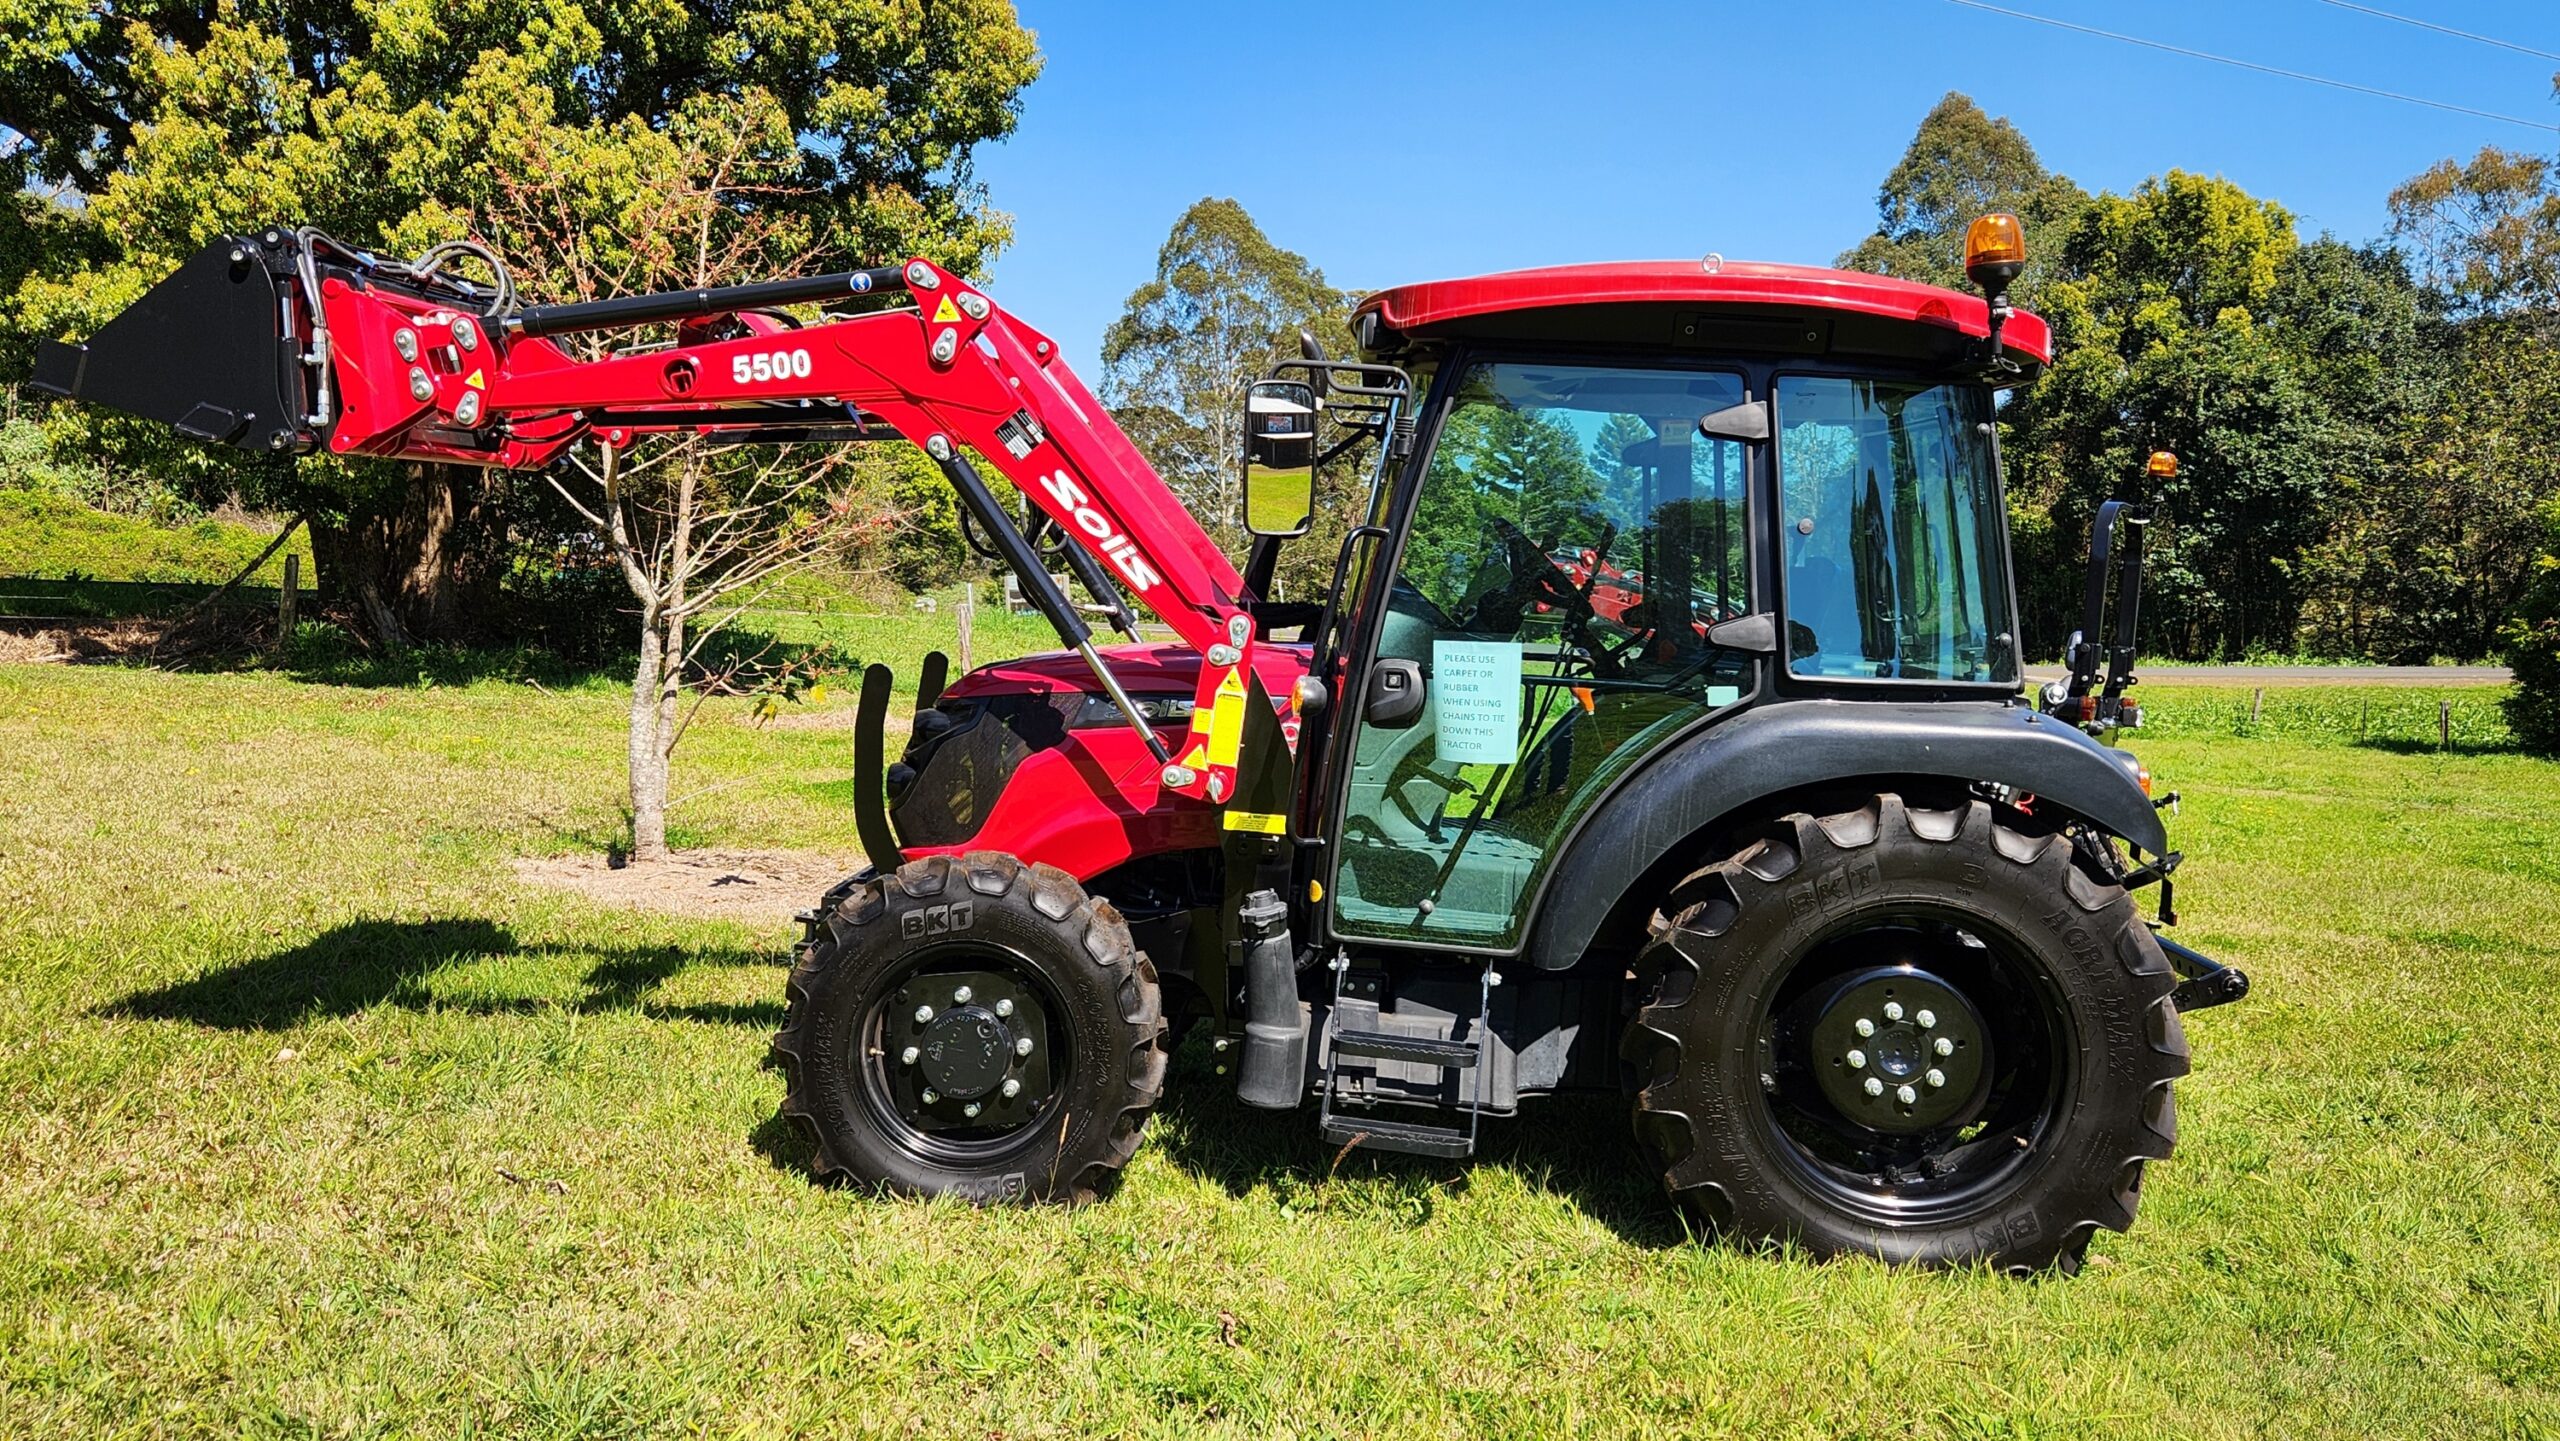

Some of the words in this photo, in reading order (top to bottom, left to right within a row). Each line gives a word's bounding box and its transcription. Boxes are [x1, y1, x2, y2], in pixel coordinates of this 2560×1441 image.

[732, 348, 811, 384] 5500
[1444, 654, 1476, 664] PLEASE
[1478, 656, 1496, 664] USE
[1443, 668, 1478, 678] CARPET
[1480, 670, 1494, 679] OR
[1443, 683, 1479, 692] RUBBER
[1442, 697, 1471, 706] WHEN
[1473, 699, 1502, 708] USING
[1442, 712, 1476, 721] CHAINS
[1477, 713, 1490, 722] TO
[1493, 714, 1505, 723] TIE
[1442, 726, 1472, 735] DOWN
[1474, 728, 1494, 737] THIS
[1442, 740, 1482, 750] TRACTOR
[1788, 857, 1878, 922] BKT
[902, 902, 973, 938] BKT
[2040, 909, 2117, 985] AGRI
